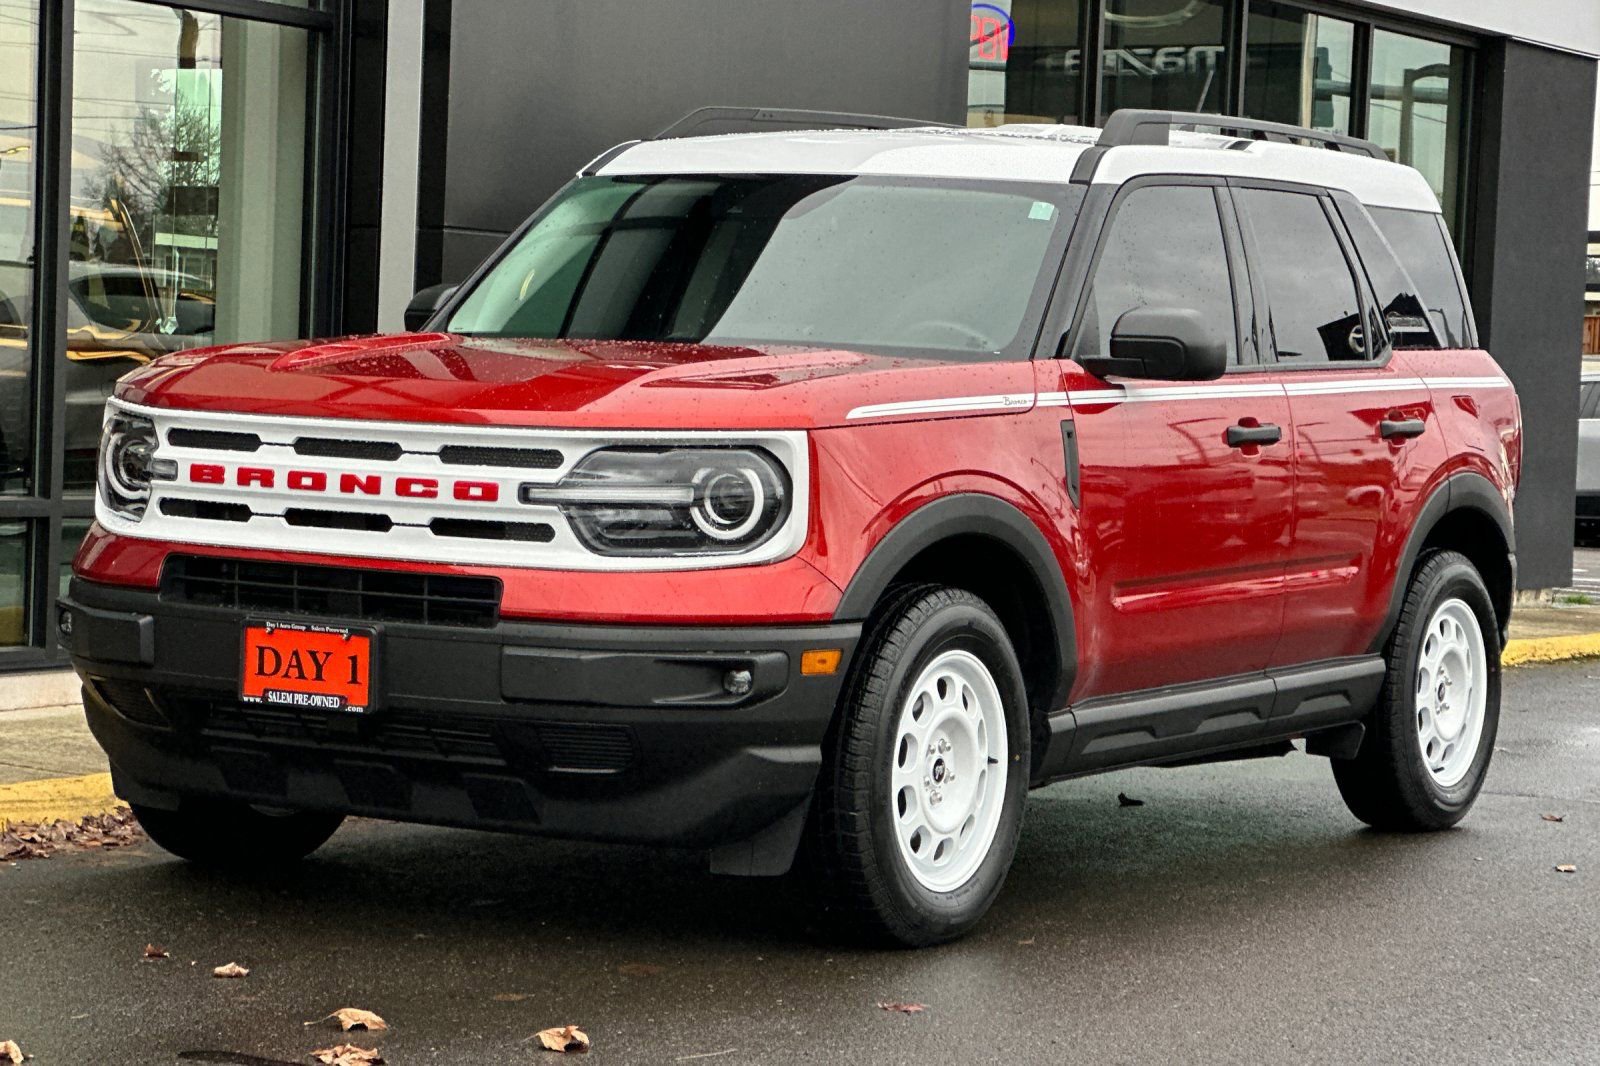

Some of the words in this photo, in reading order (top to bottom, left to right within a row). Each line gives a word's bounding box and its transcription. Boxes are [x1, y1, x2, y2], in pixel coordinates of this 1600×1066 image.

[970, 15, 1009, 60] PEN
[1002, 396, 1028, 406] Bronco
[189, 463, 499, 502] BRONCO
[266, 621, 276, 629] Day
[254, 645, 333, 682] DAY
[347, 654, 362, 685] 1
[243, 695, 263, 703] www.
[267, 690, 293, 705] SALEM
[294, 694, 340, 708] PRE-OWNED
[345, 704, 364, 713] .com
